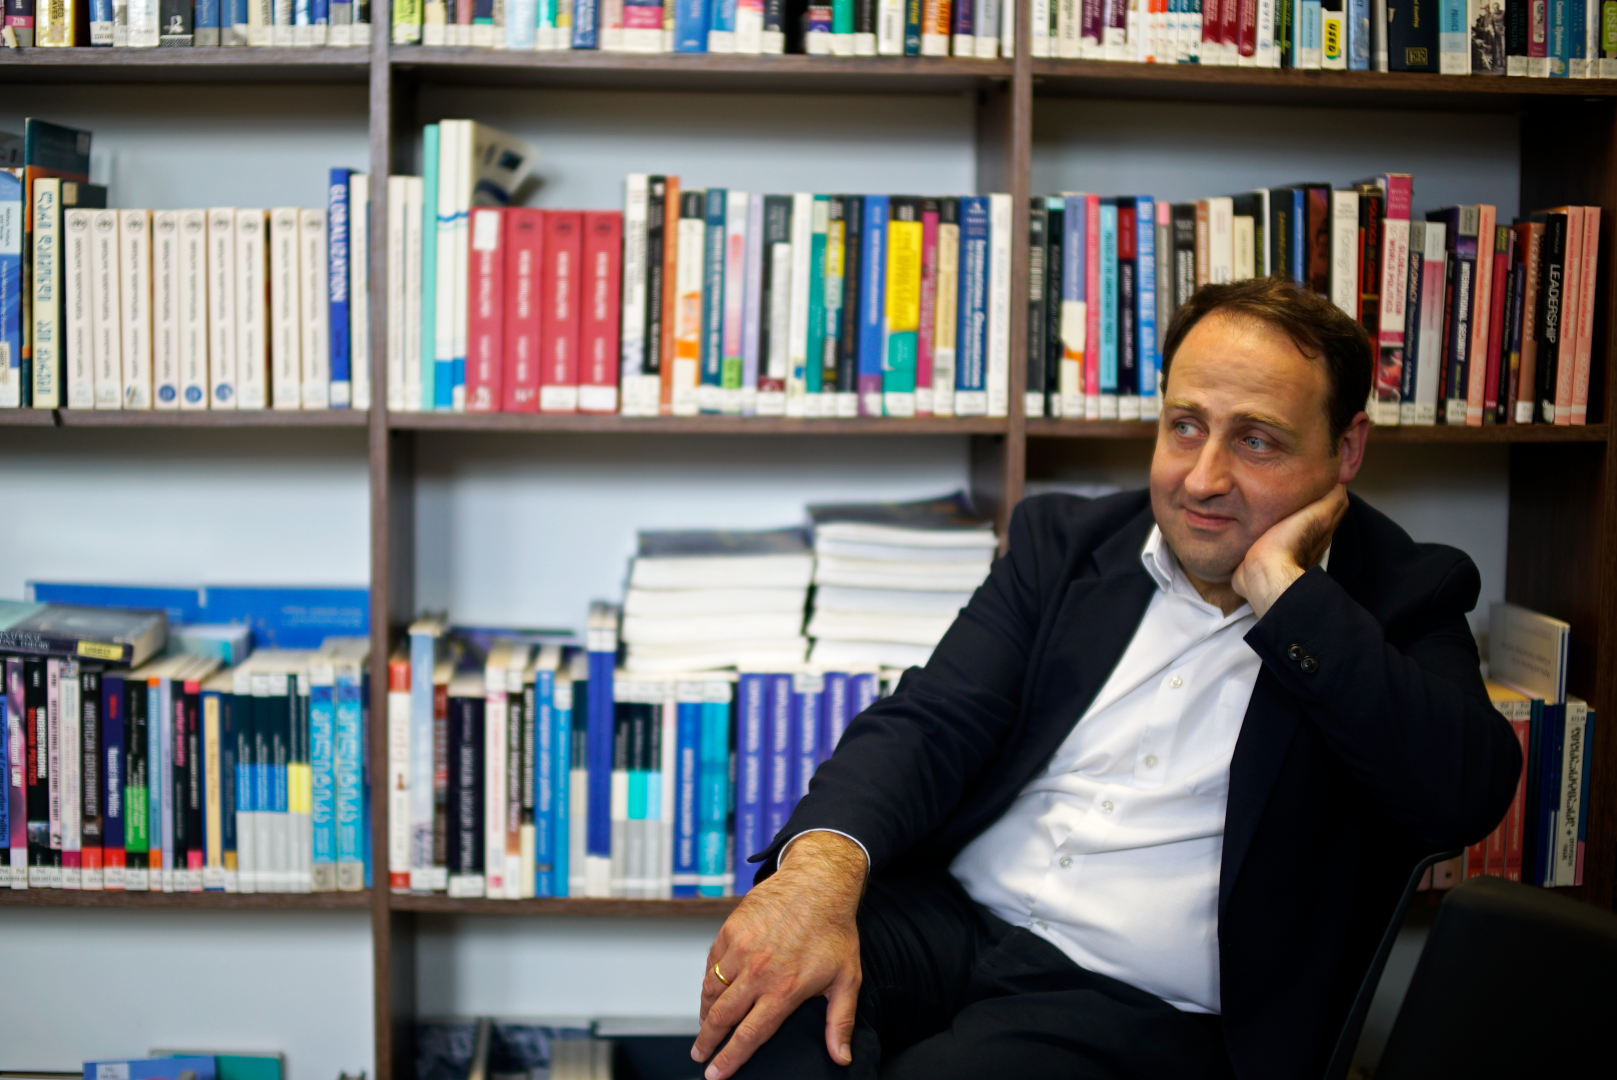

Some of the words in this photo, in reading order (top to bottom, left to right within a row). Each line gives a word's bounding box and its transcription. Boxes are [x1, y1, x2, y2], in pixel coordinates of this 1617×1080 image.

[1451, 9, 1459, 31] POLITICS
[1510, 2, 1519, 47] HUNTINGTON
[1556, 1, 1564, 25] Coercive
[1328, 23, 1338, 52] USED
[1554, 26, 1564, 56] Diplomacy
[330, 184, 346, 302] GLOBALIZATION
[1367, 198, 1378, 246] POLITICS
[1338, 228, 1354, 276] Foreign
[1388, 240, 1396, 270] WORLD
[1530, 232, 1539, 283] RICHARD
[974, 240, 987, 308] INTERNATIONAL
[1367, 260, 1376, 294] CHINA
[1386, 272, 1395, 314] POLITICS
[1395, 246, 1406, 315] GLOBALIZATION
[1410, 253, 1420, 303] DIPLOMACY
[1459, 262, 1471, 322] INTERNATIONAL
[1526, 305, 1534, 341] HAASS
[1545, 263, 1561, 344] LEADERSHIP
[1456, 323, 1468, 362] SECURITY
[1560, 354, 1572, 405] NISPAcee
[1576, 353, 1588, 403] NISPAcee
[11, 716, 20, 765] International
[28, 707, 37, 746] RUSSIAN
[37, 707, 47, 778] UNDERSTANDING
[84, 701, 96, 751] AMERICAN
[510, 706, 519, 748] European
[540, 705, 549, 747] european
[12, 767, 21, 787] LAW
[28, 748, 37, 786] POLITICS
[85, 753, 97, 816] GOVERNMENT
[510, 751, 520, 800] Integration
[109, 794, 119, 818] Politics
[539, 778, 550, 811] politics
[510, 802, 519, 832] Theory
